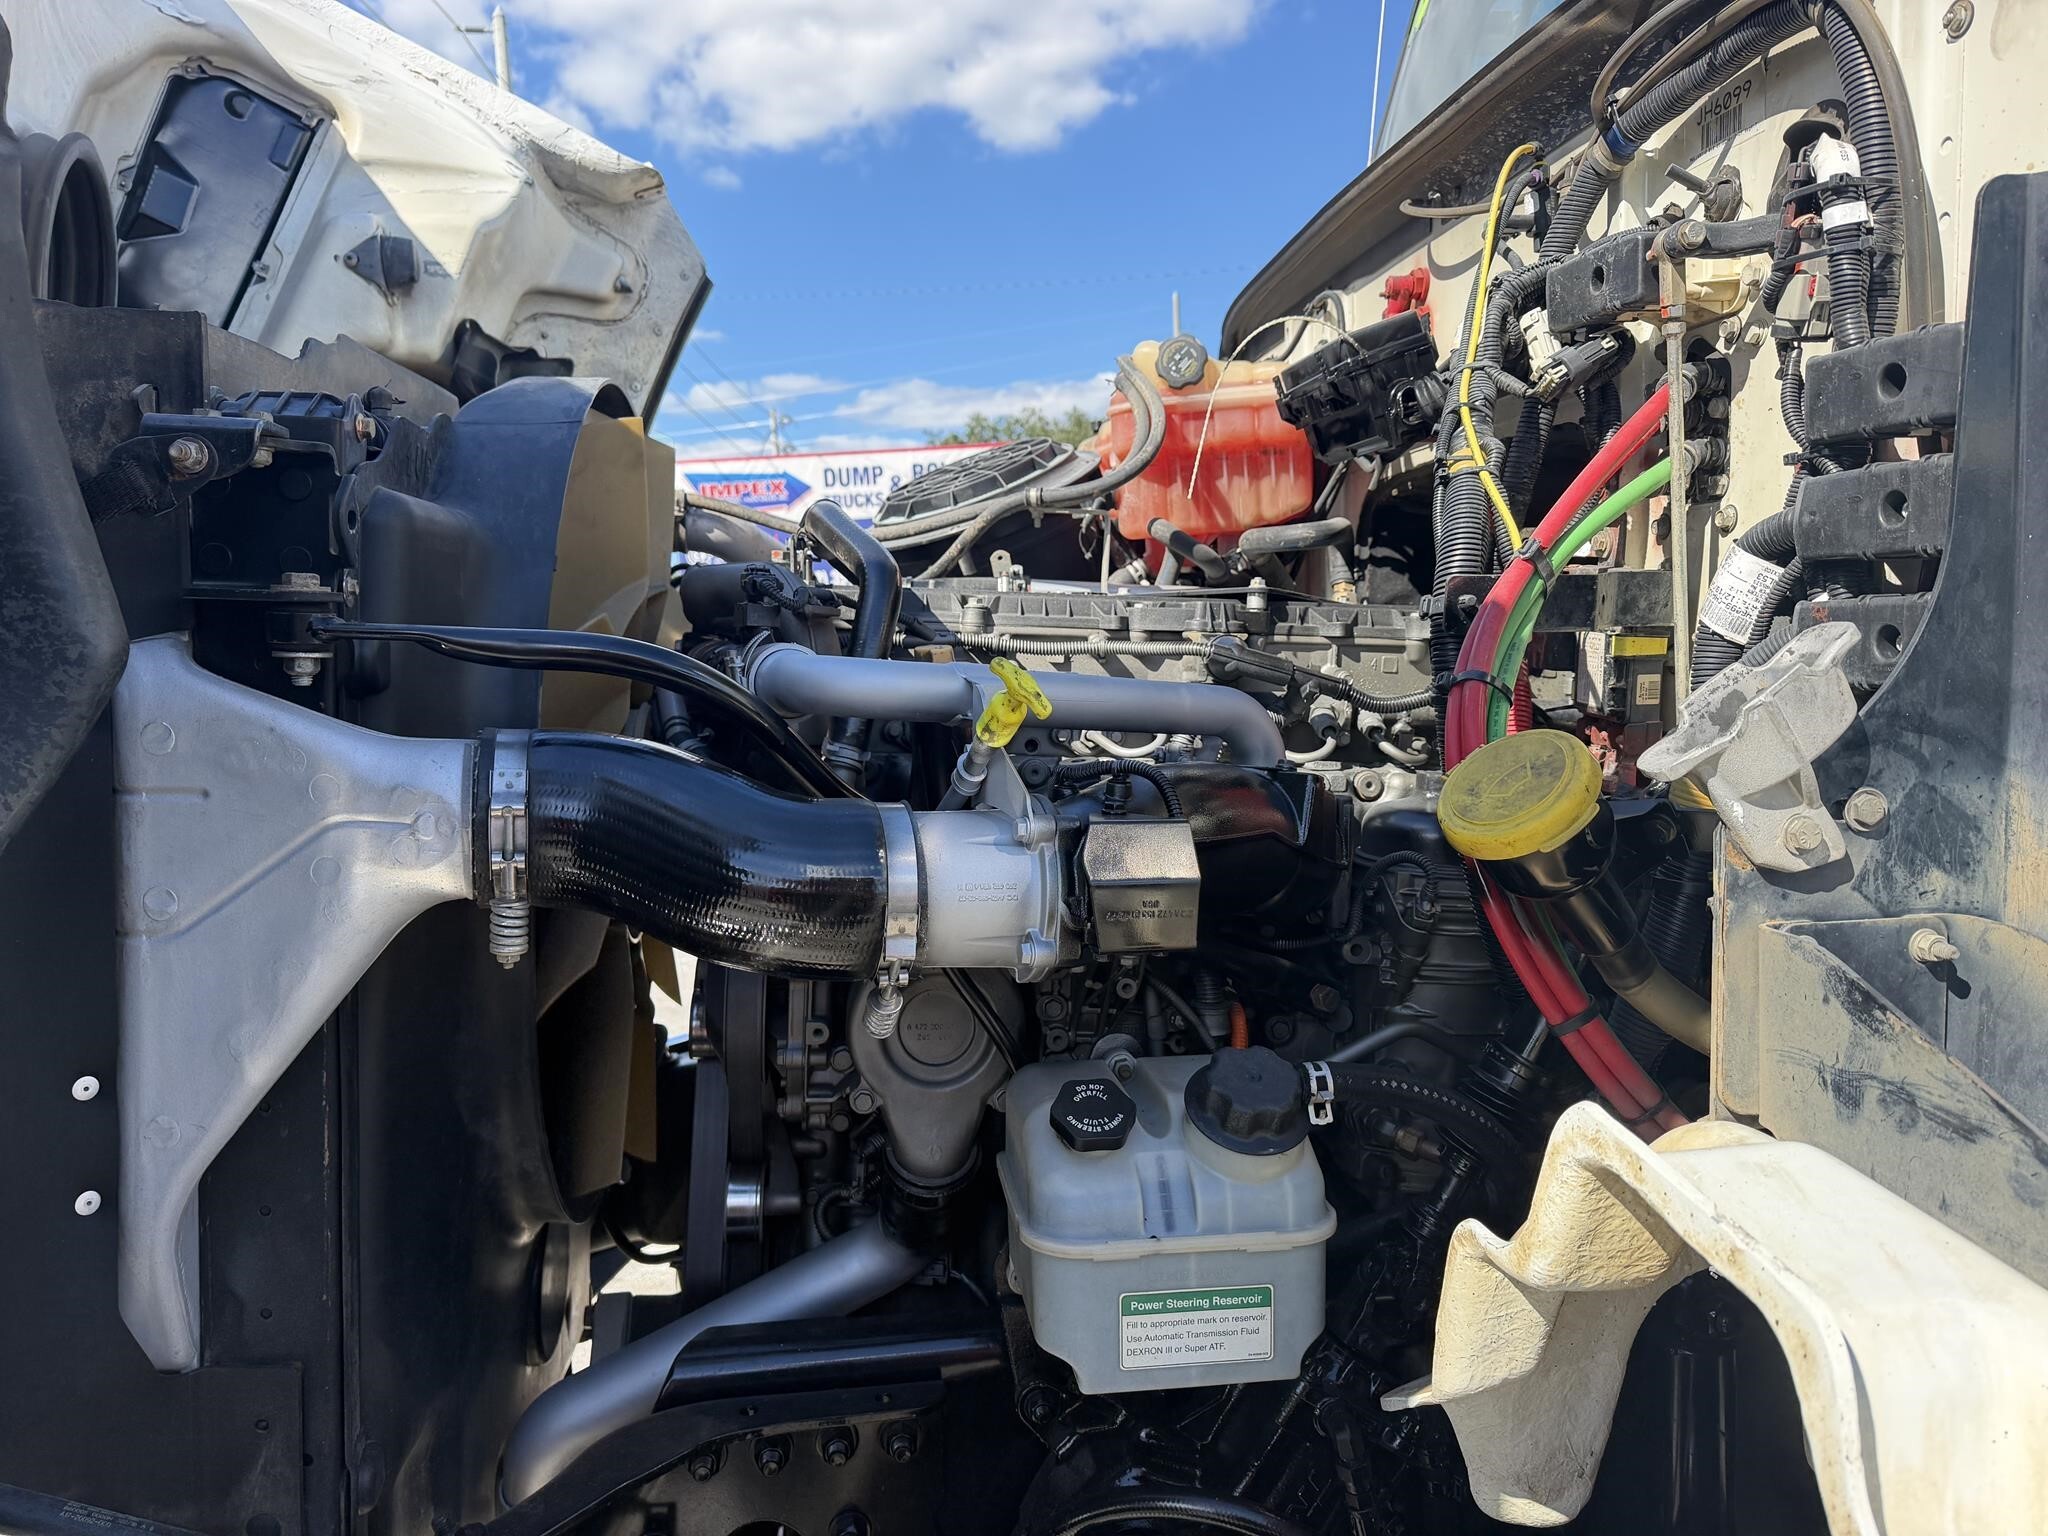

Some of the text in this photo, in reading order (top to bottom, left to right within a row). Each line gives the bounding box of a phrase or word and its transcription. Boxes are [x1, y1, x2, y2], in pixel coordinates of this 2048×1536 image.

[1696, 79, 1753, 126] JH6099
[823, 465, 884, 488] DUMP
[890, 475, 901, 492] &
[700, 479, 787, 498] IMPEX
[824, 492, 884, 508] RUCKS
[1075, 1083, 1105, 1092] DO NOT
[1073, 1090, 1108, 1102] OVERFILL
[1066, 1113, 1124, 1132] POWER STEERING
[1083, 1116, 1109, 1126] FLUID
[1130, 1293, 1263, 1312] Power Steering Reservoir
[1126, 1313, 1268, 1330] Fill to appropriate mark on reservoir.
[1126, 1327, 1260, 1343] Use Automatic Transmission Fluid
[1126, 1342, 1226, 1357] DEXRON III or Super ATF.
